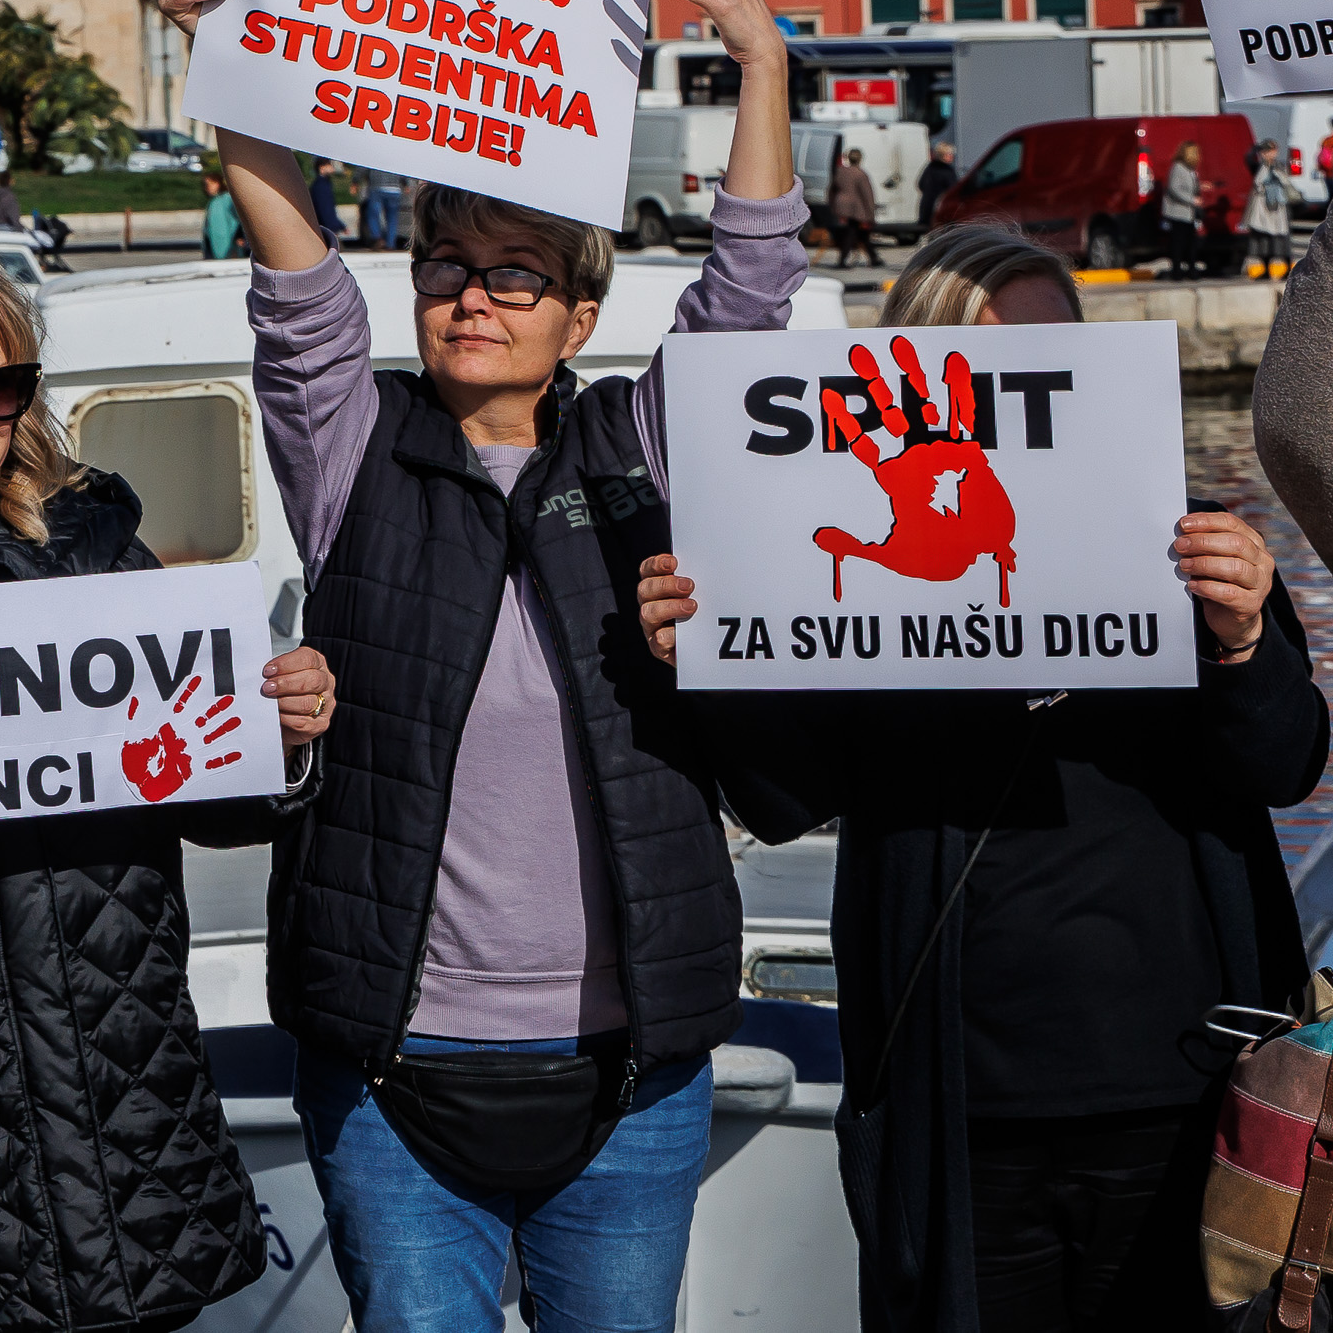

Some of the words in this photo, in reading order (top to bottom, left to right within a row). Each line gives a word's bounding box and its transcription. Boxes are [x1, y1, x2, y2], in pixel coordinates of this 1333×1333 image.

[239, 10, 598, 138] STUDENTIMA
[311, 80, 526, 167] SRBIJE!
[745, 371, 1073, 456] SPLIT
[718, 617, 774, 659] ZA
[791, 616, 880, 659] SVU
[901, 603, 1022, 659] NAŠU
[1043, 613, 1158, 658] DICU
